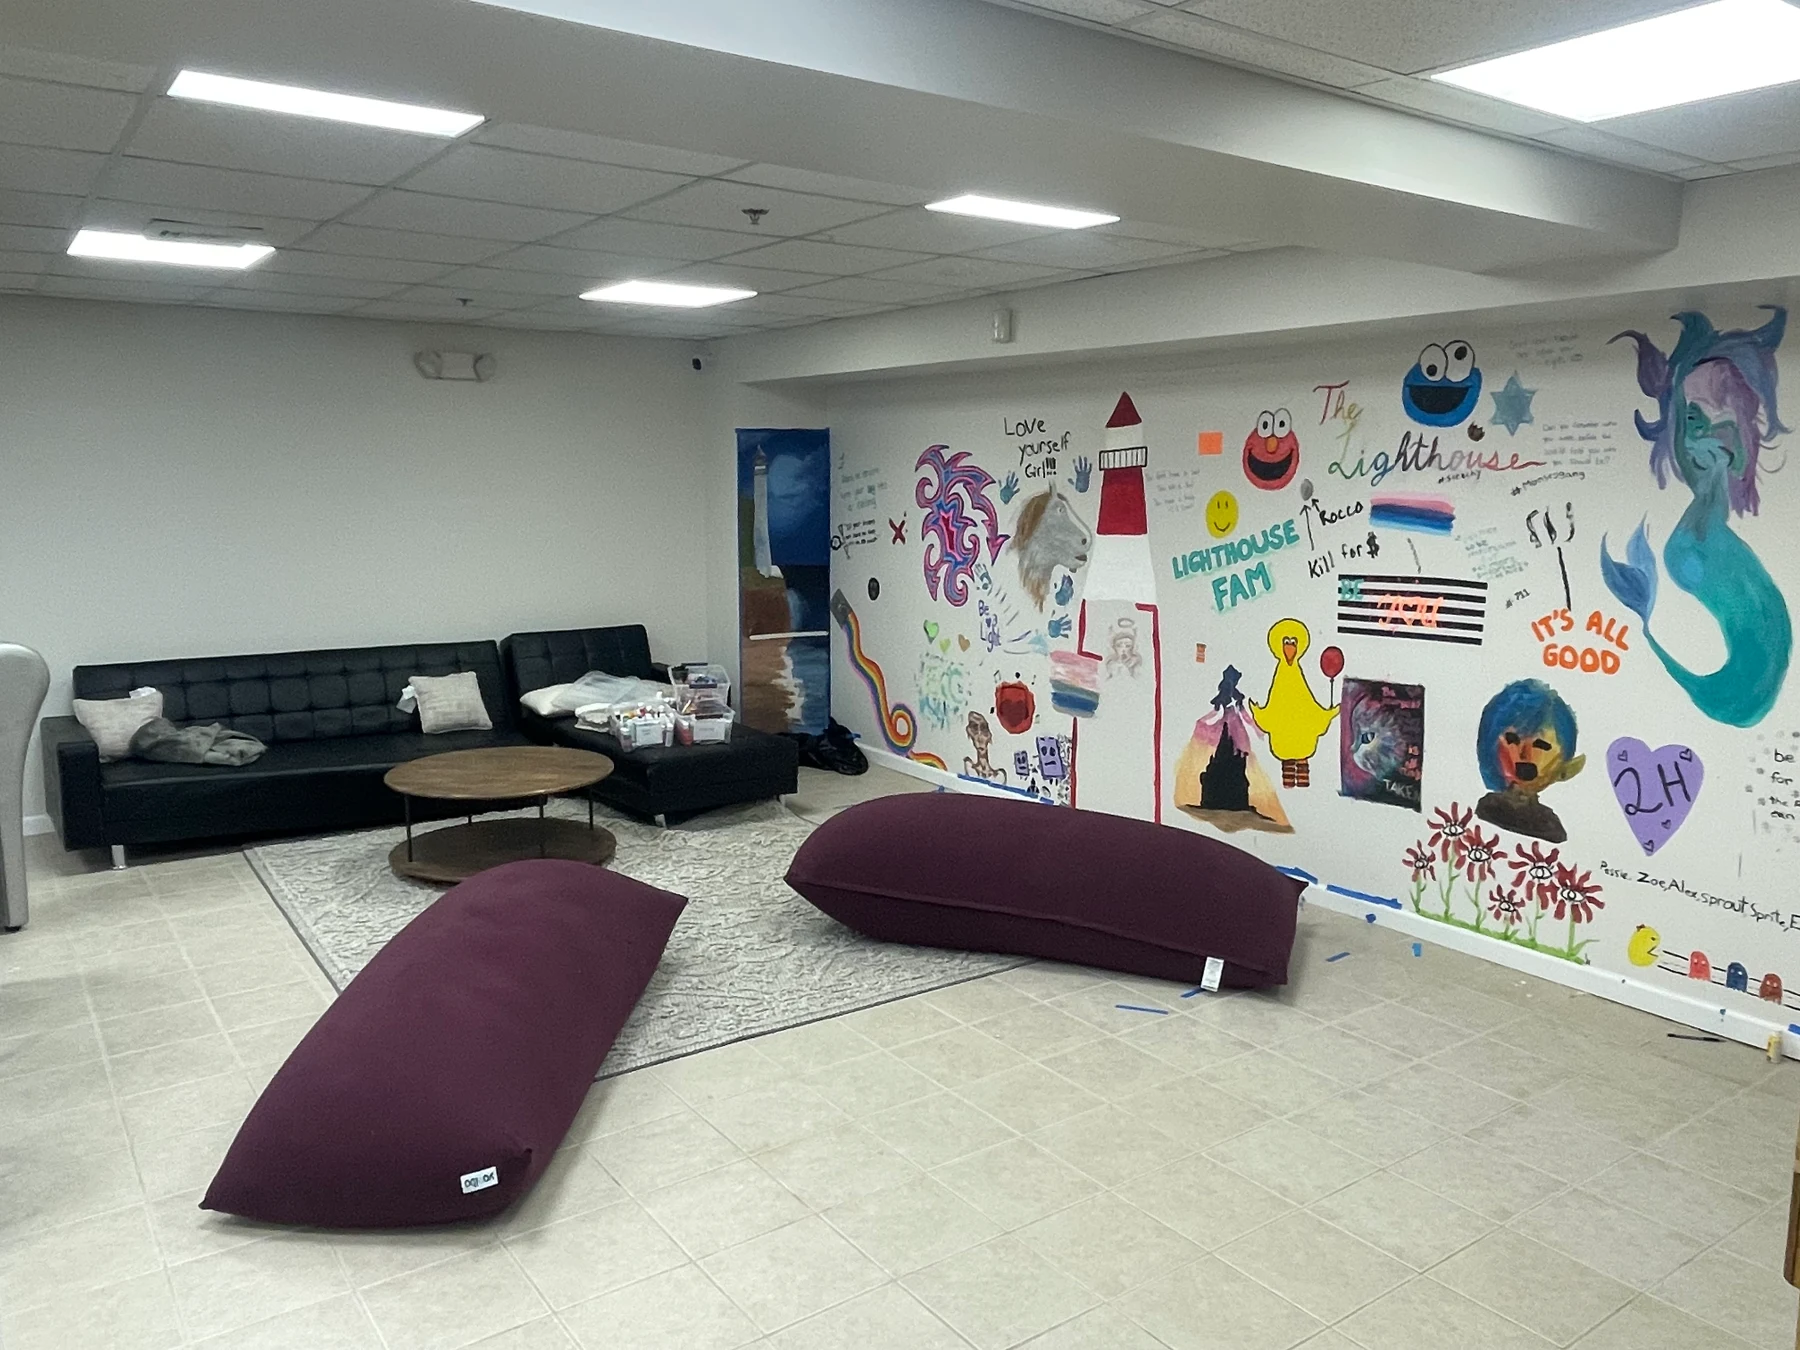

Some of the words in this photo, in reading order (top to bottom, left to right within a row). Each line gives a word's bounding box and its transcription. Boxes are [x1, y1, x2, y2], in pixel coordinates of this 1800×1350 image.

[1313, 380, 1363, 425] The
[1003, 416, 1047, 438] Love
[1018, 430, 1071, 467] yourself
[1327, 416, 1548, 488] Lighthouse
[1171, 518, 1301, 580] LIGHTHOUSE
[1340, 543, 1363, 560] for
[1211, 560, 1272, 612] FAM
[1530, 608, 1575, 643] IT'S
[1585, 610, 1630, 652] ALL
[1542, 643, 1621, 676] GOOD
